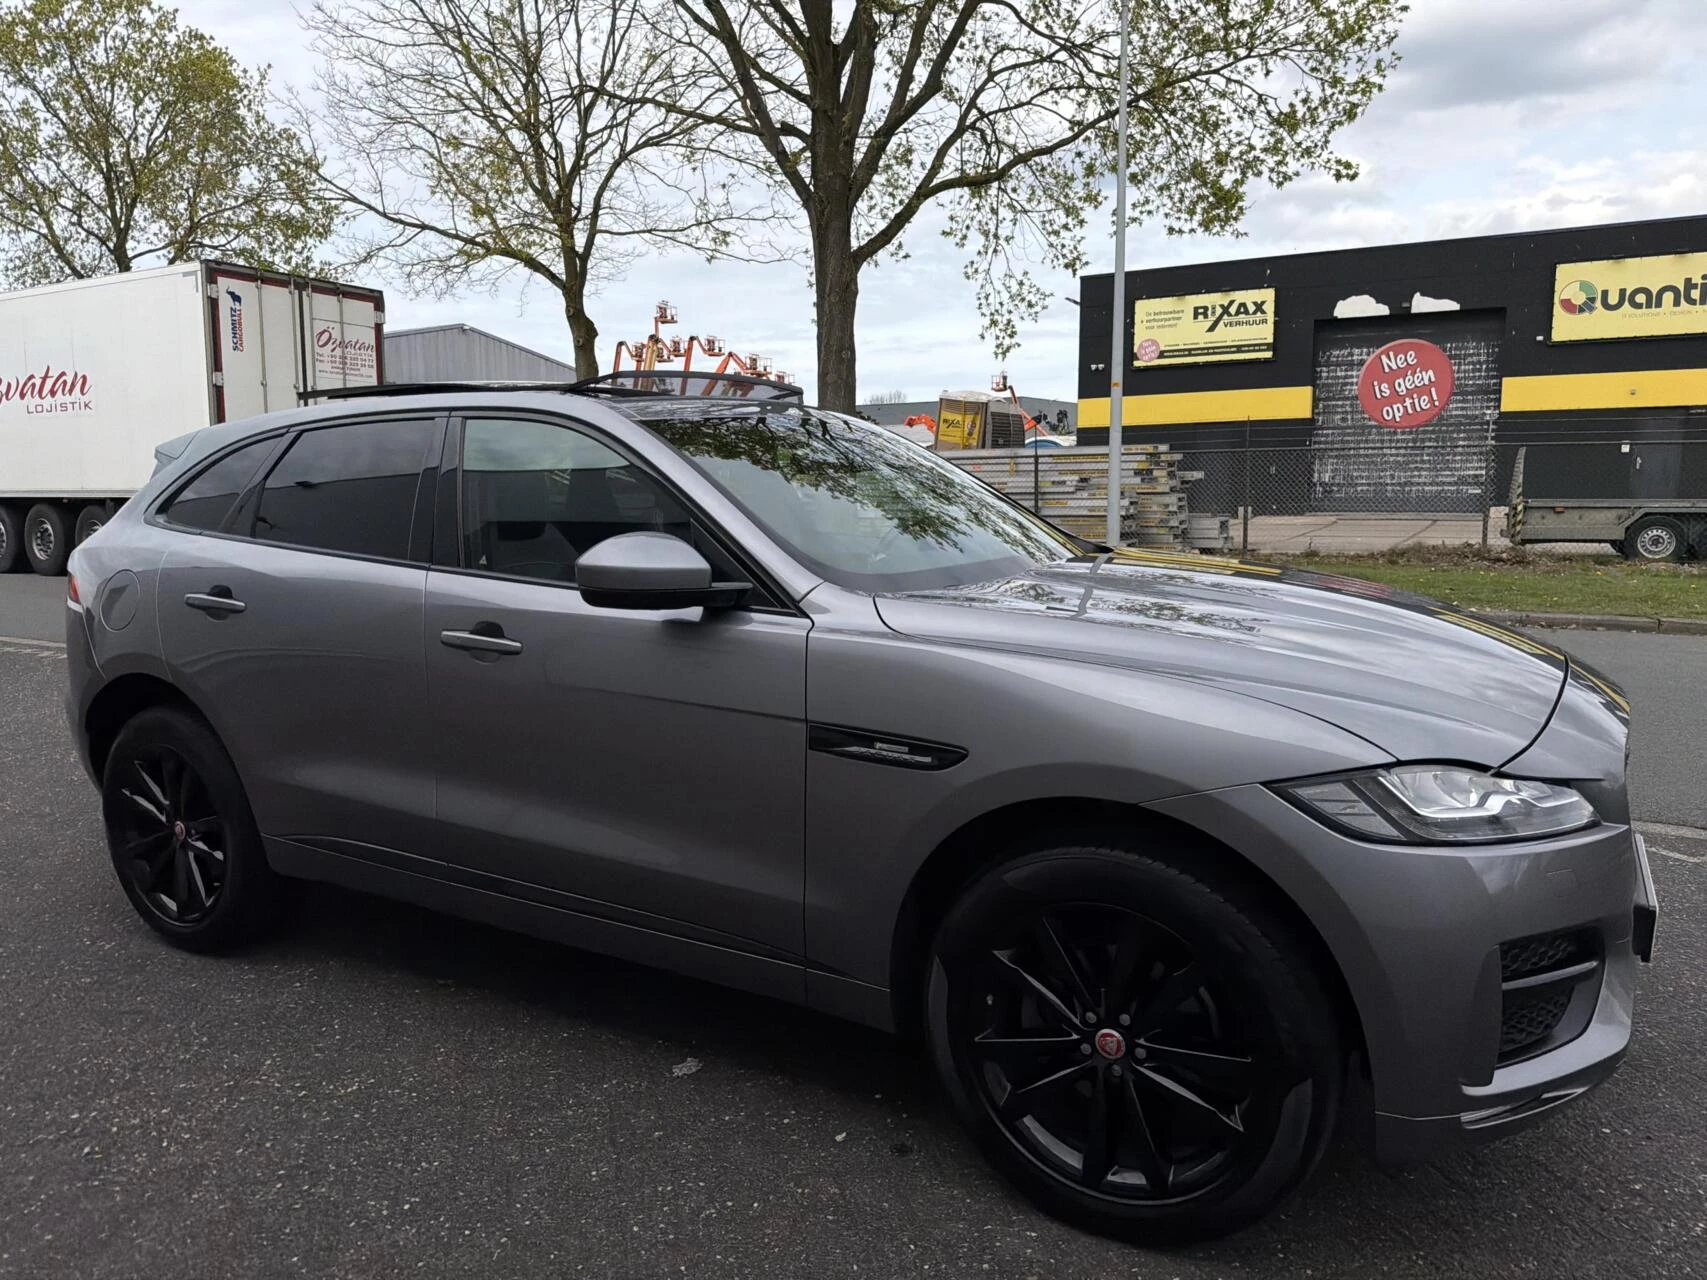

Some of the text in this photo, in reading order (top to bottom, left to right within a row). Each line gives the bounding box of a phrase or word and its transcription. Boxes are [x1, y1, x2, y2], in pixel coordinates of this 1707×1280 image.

[230, 306, 239, 352] SCHMITZ
[1223, 318, 1268, 328] VERHUUR
[1380, 350, 1418, 374] Nee
[1373, 367, 1436, 400] is géén
[26, 397, 93, 415] LOJİSTİK
[1382, 387, 1440, 422] optie!
